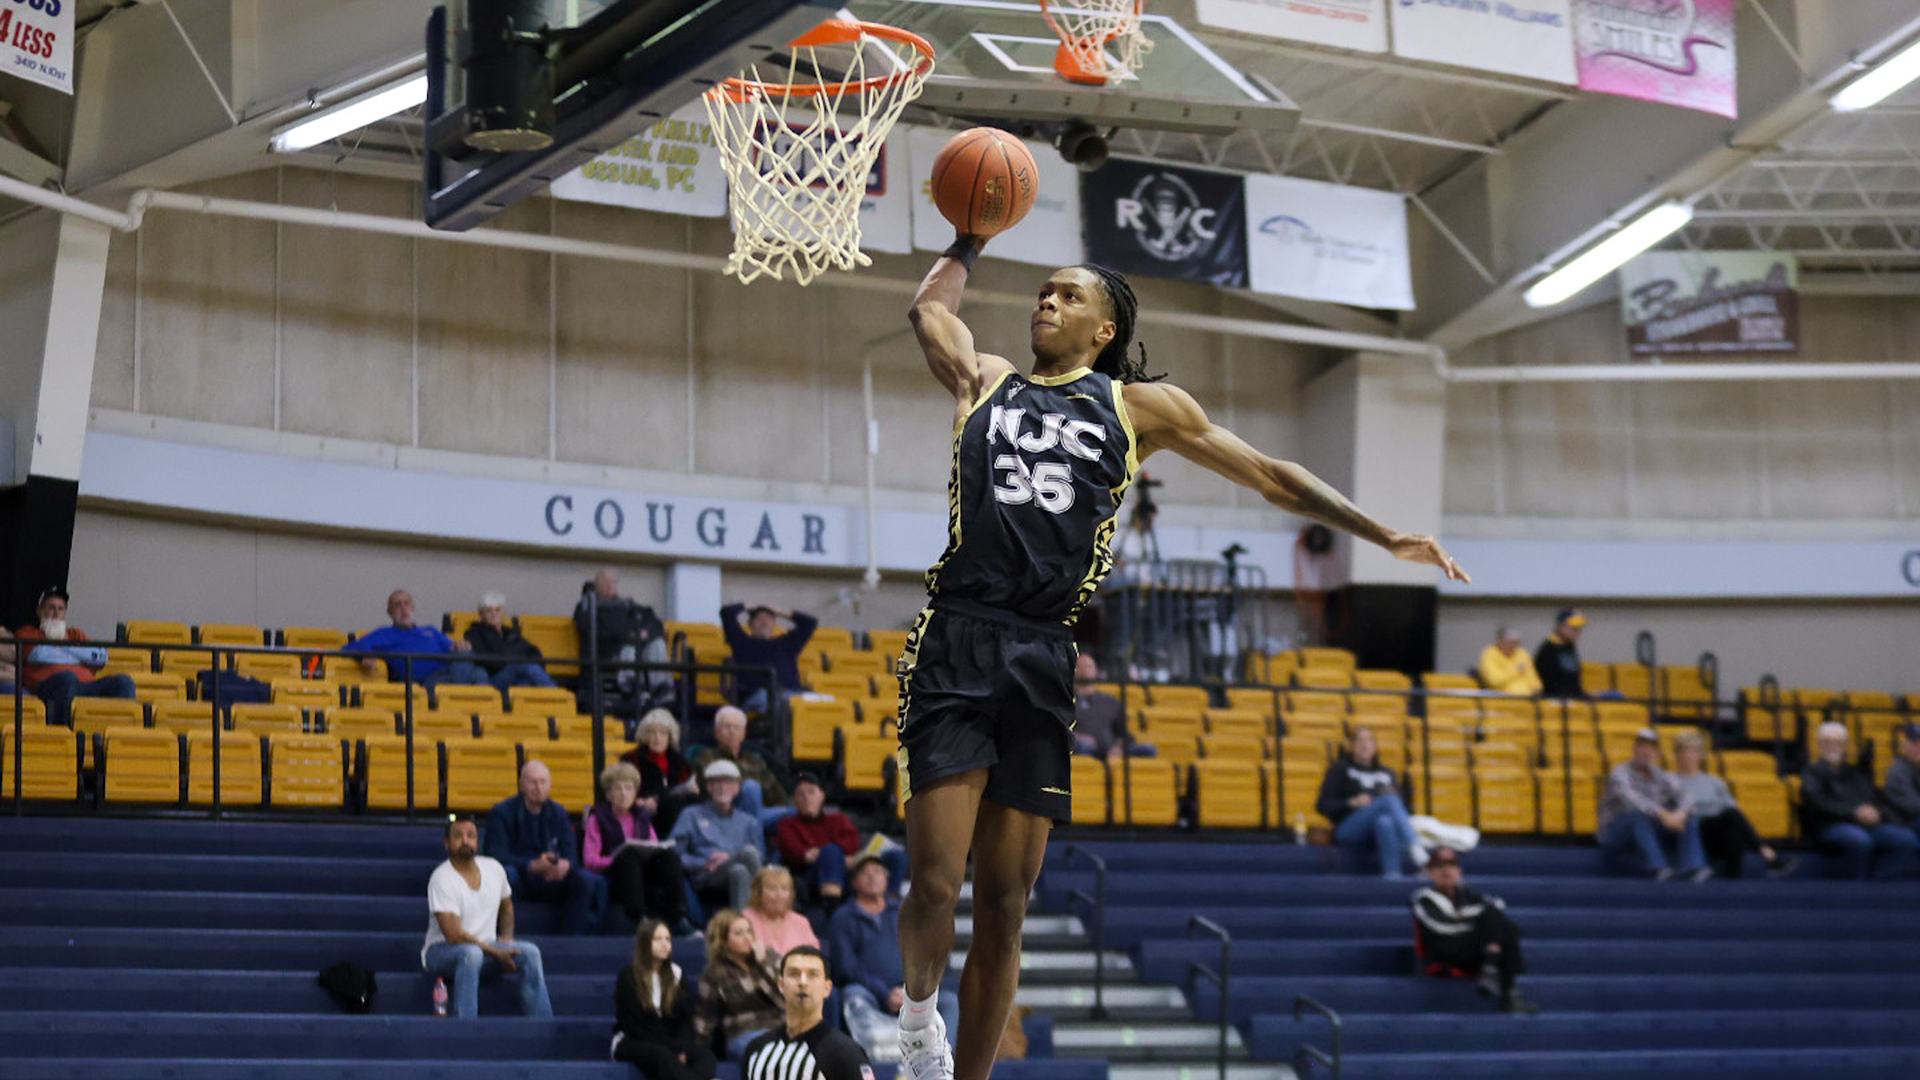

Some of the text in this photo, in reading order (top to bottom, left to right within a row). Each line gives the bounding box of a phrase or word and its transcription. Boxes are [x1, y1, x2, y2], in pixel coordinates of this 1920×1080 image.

[12, 21, 56, 59] LESS
[656, 143, 700, 166] AND
[666, 166, 696, 192] PC
[986, 404, 1107, 462] NJC
[994, 454, 1076, 515] 35
[544, 494, 827, 554] COUGAR
